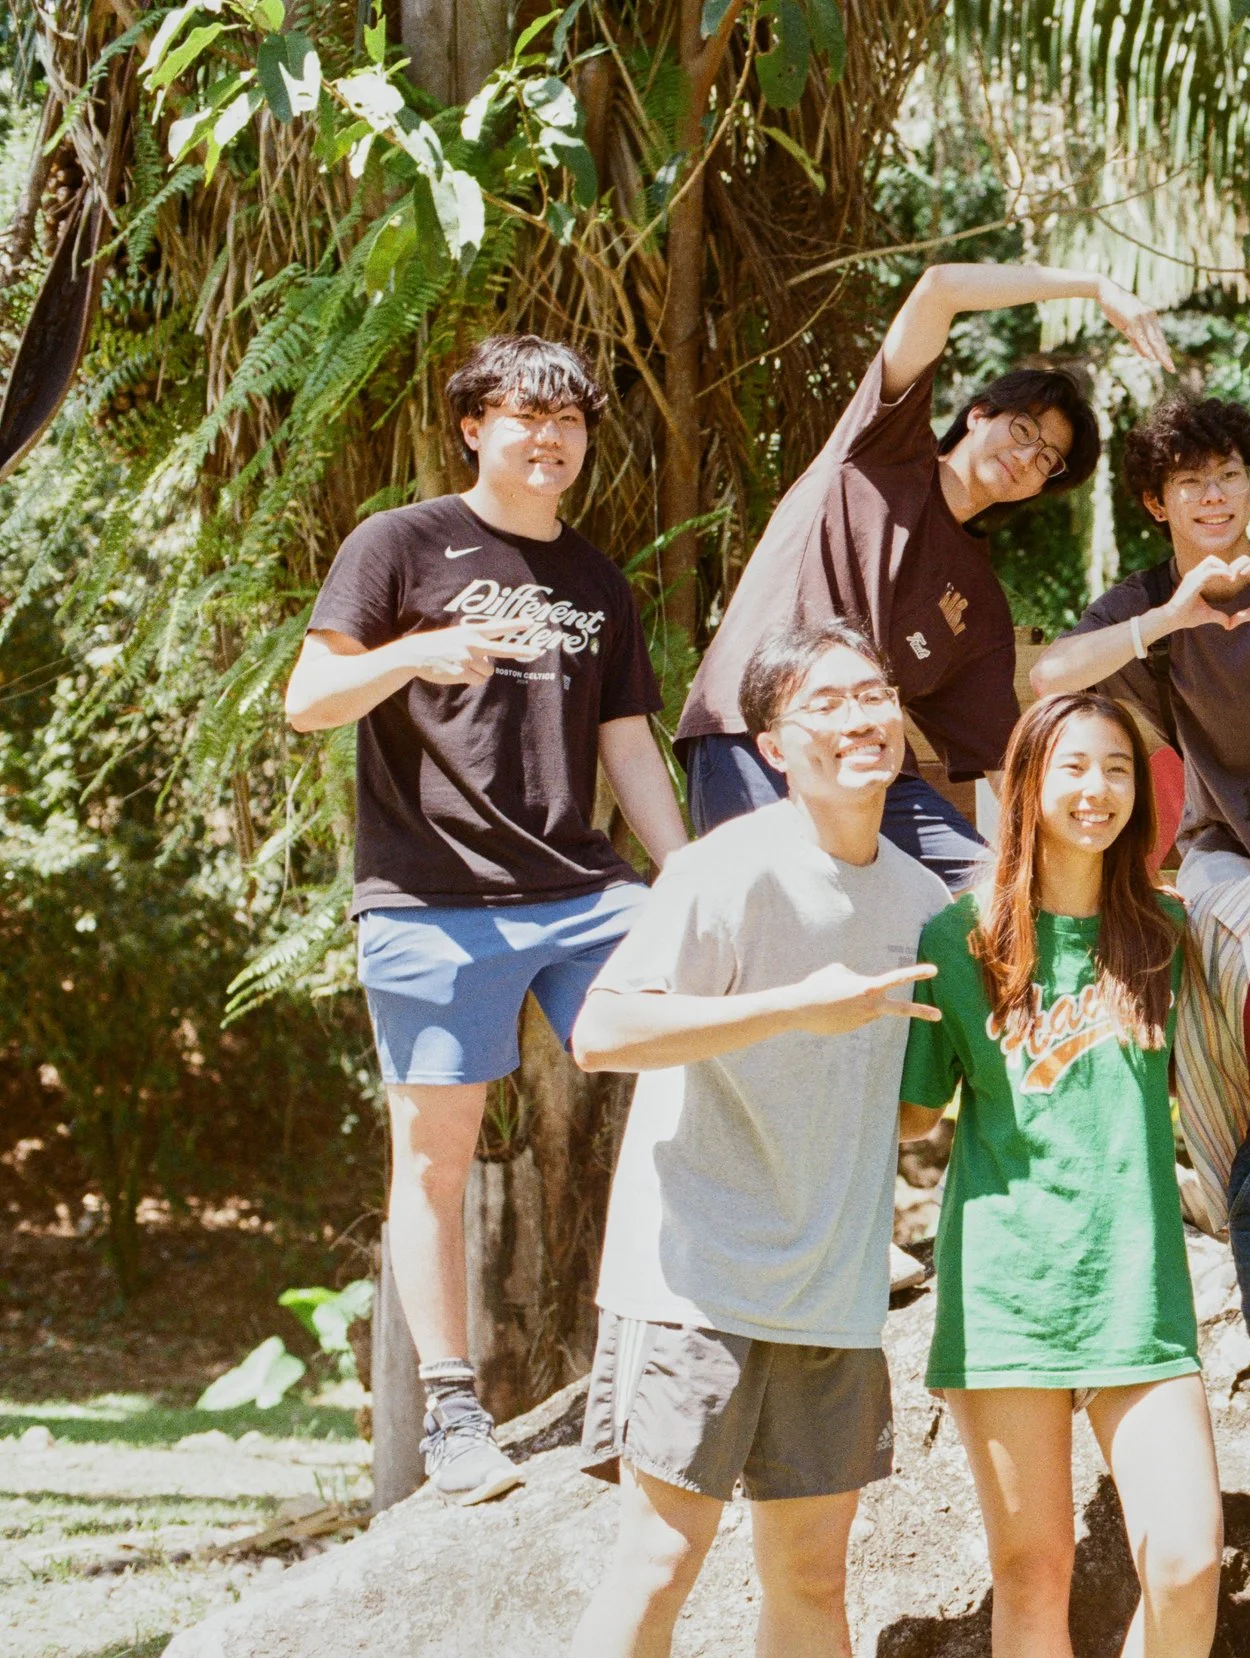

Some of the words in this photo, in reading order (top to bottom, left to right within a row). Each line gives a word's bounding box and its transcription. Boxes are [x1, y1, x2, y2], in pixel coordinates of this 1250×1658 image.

[443, 579, 605, 634] Different
[495, 667, 523, 678] BOSTON
[523, 671, 556, 681] CELTICS
